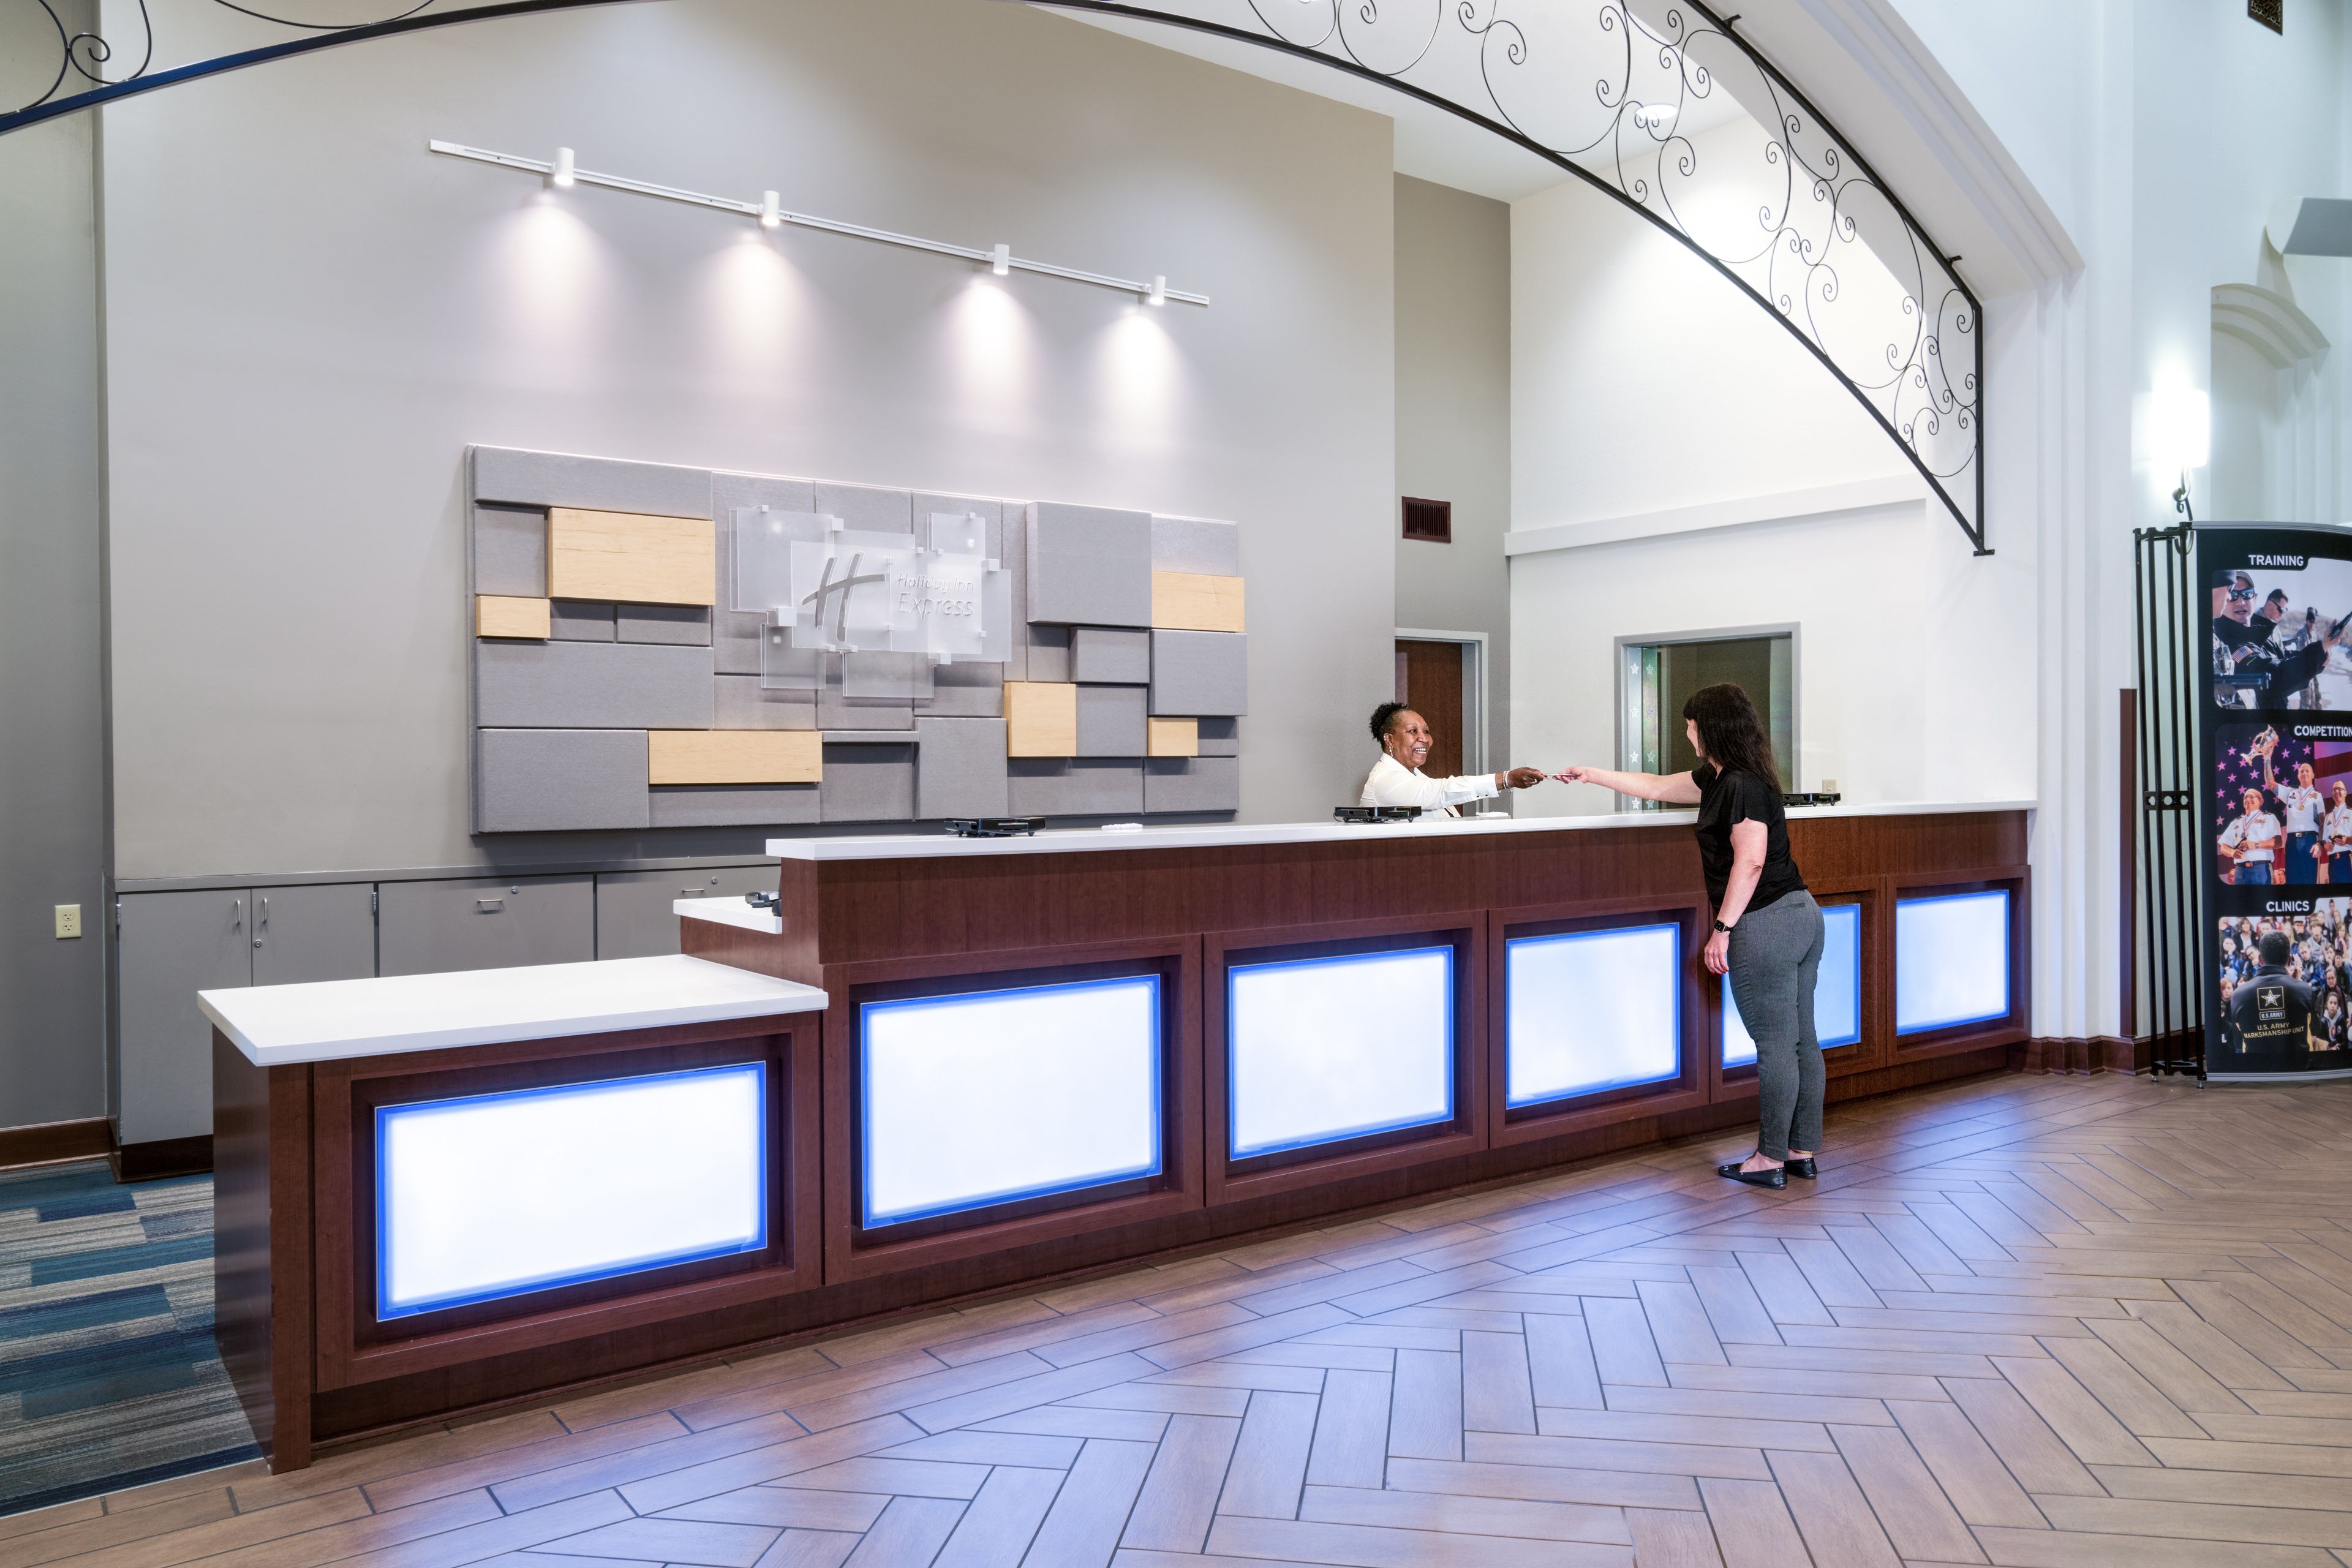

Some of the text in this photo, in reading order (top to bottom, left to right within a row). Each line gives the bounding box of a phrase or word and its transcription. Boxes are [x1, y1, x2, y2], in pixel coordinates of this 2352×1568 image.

[2248, 554, 2304, 567] TRAINING
[897, 572, 974, 594] Holiday Inn
[899, 592, 975, 620] Express
[2266, 901, 2310, 912] CLINICS
[2244, 1030, 2291, 1039] MARKSMANSHIP
